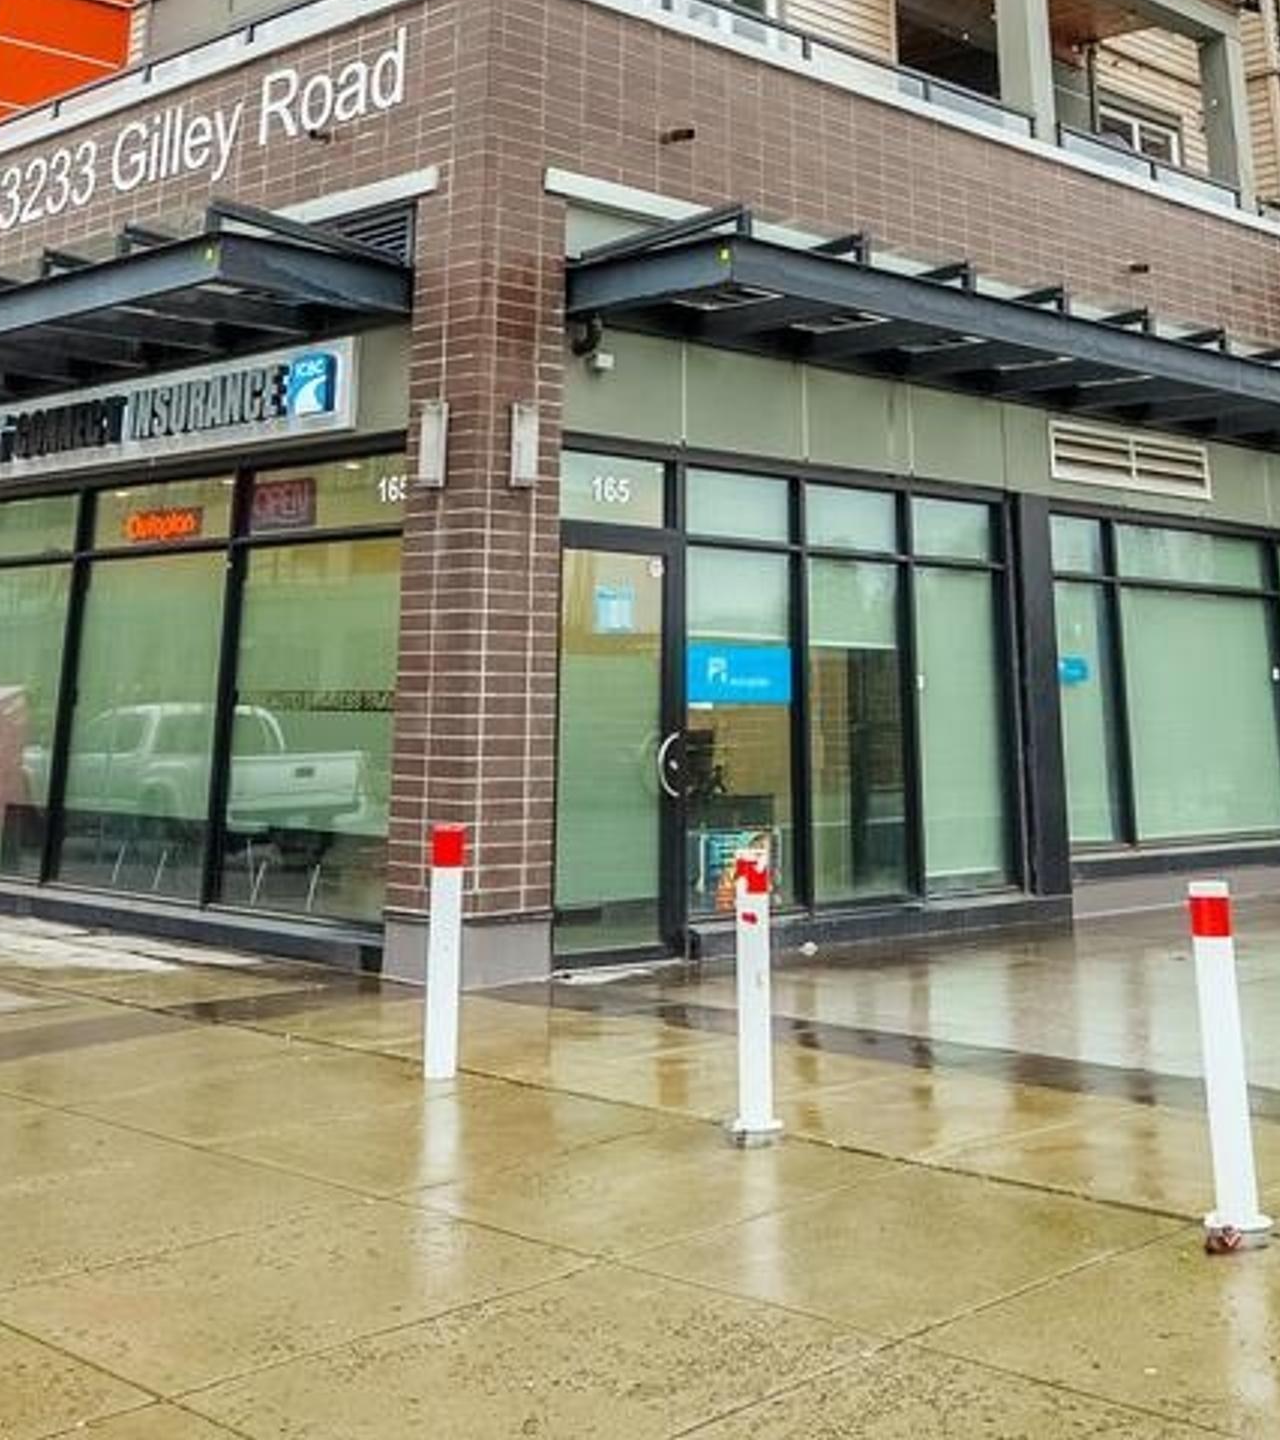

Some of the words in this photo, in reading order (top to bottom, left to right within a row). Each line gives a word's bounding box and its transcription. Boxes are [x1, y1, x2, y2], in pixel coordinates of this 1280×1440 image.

[111, 103, 243, 190] Gilley
[258, 27, 408, 145] Road
[124, 366, 288, 440] INSURANCE
[592, 477, 630, 502] 165
